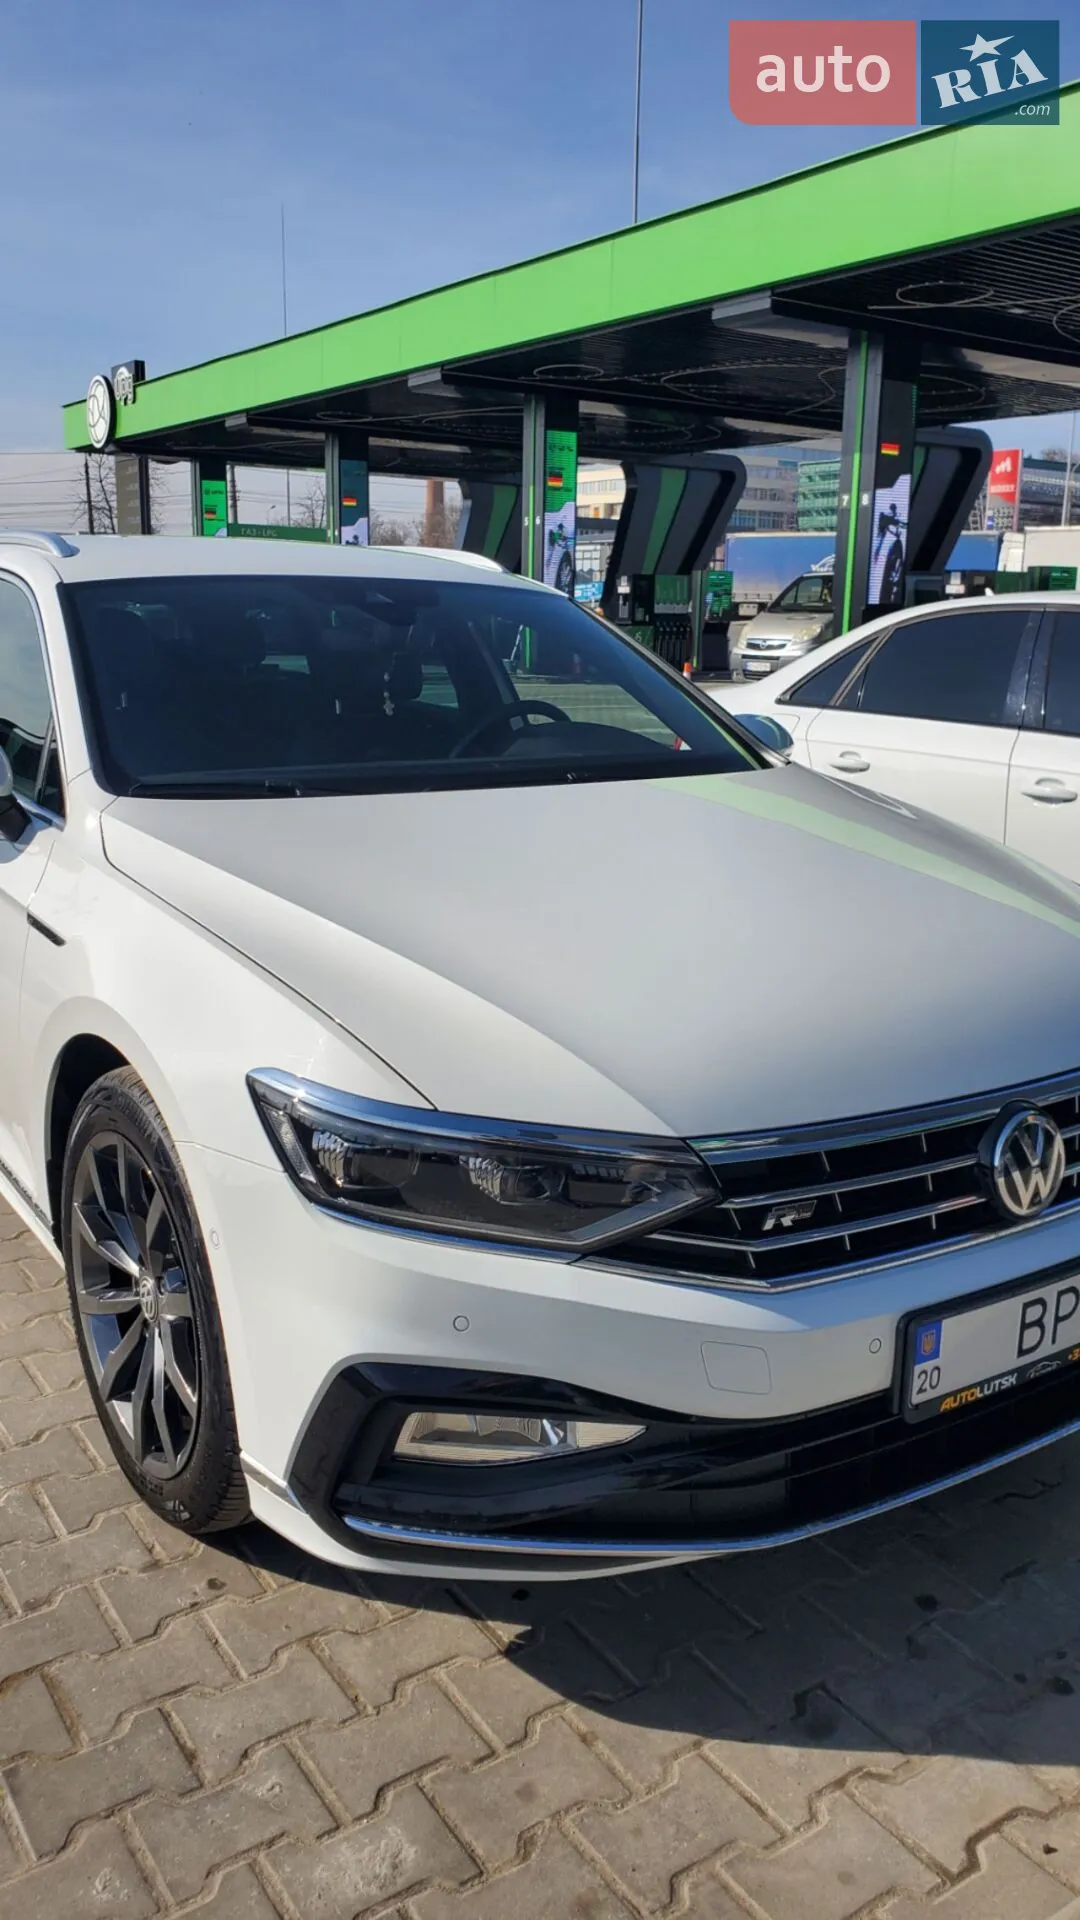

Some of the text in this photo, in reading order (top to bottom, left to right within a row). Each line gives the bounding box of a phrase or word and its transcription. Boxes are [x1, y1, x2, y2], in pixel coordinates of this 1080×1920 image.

[842, 494, 850, 506] 7
[1017, 1286, 1080, 1358] BP
[916, 1366, 941, 1396] 20
[940, 1372, 1018, 1412] AUTOLUTSK
